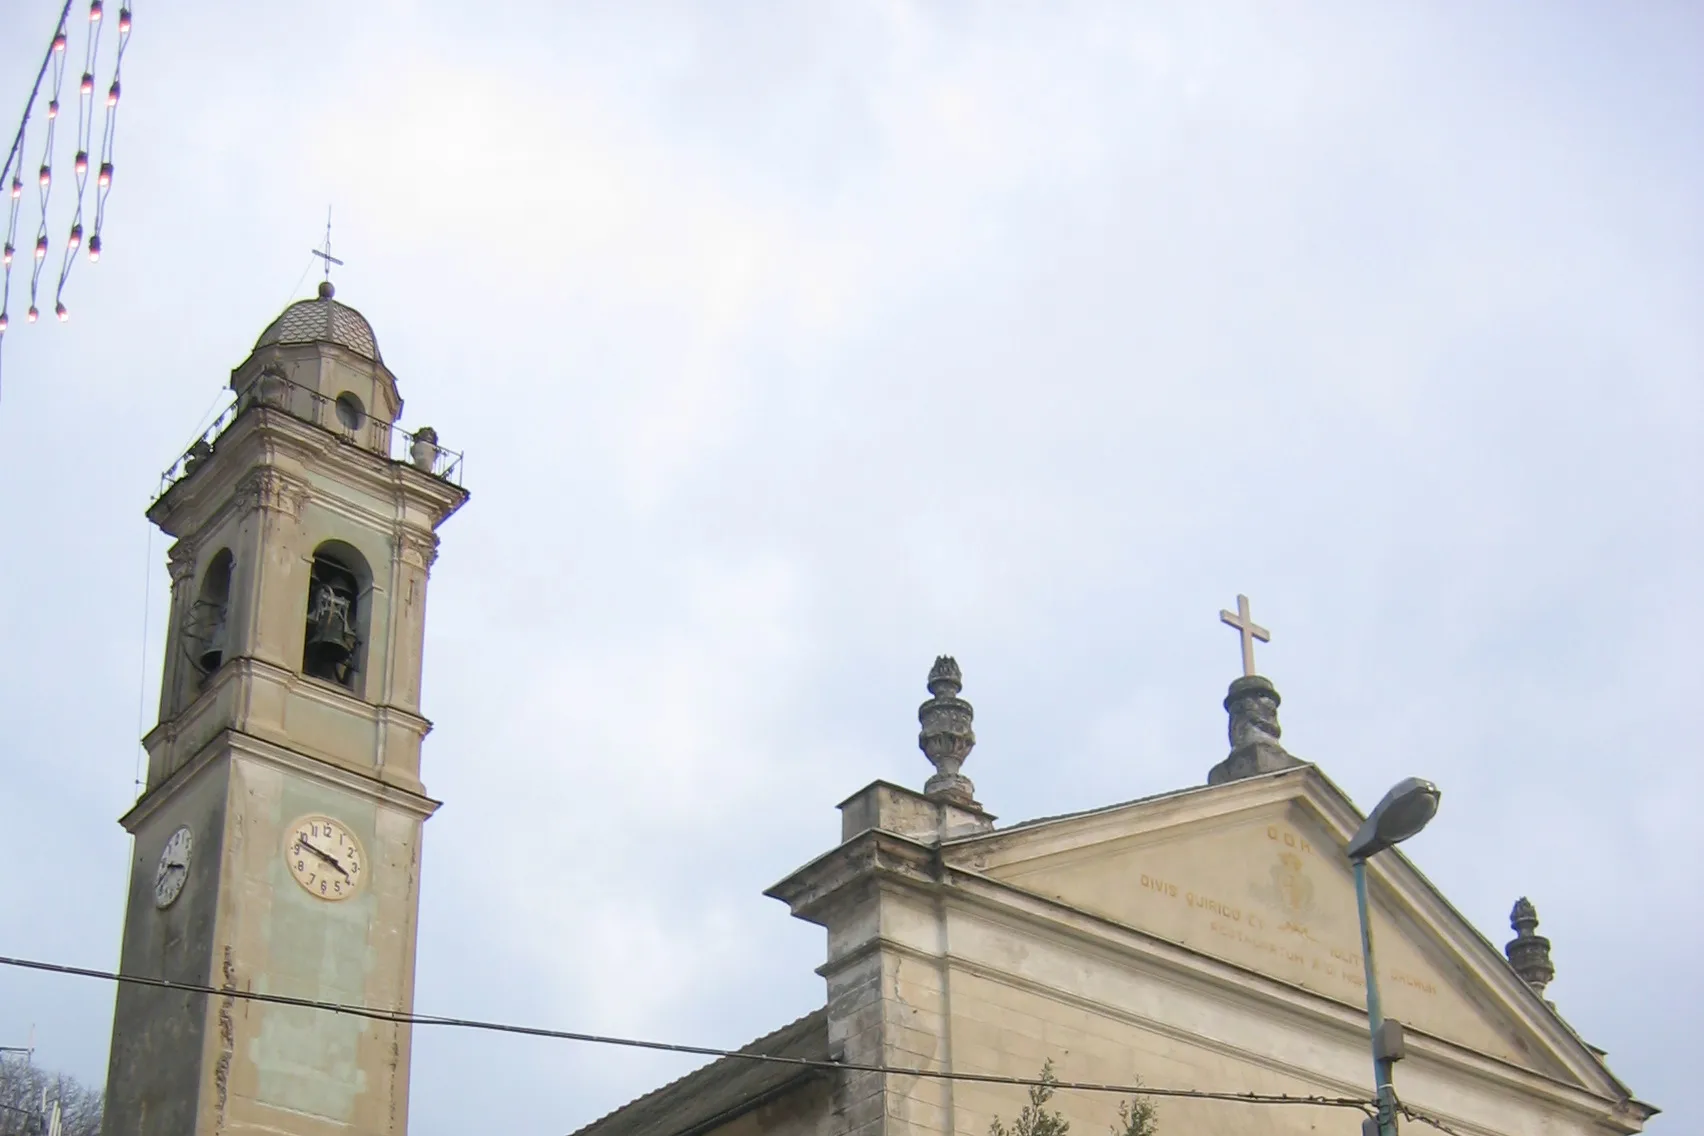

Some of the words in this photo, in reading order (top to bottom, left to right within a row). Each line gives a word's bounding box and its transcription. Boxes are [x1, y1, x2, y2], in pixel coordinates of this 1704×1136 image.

[323, 825, 332, 838] 12
[293, 844, 300, 855] 9
[347, 846, 354, 859] 2
[297, 860, 304, 871] 8
[351, 862, 358, 874] 3
[309, 873, 316, 885] 7
[320, 880, 327, 892] 6
[334, 880, 341, 892] 5
[1140, 873, 1179, 898] DIVIS
[1185, 891, 1241, 922] QUIRICO
